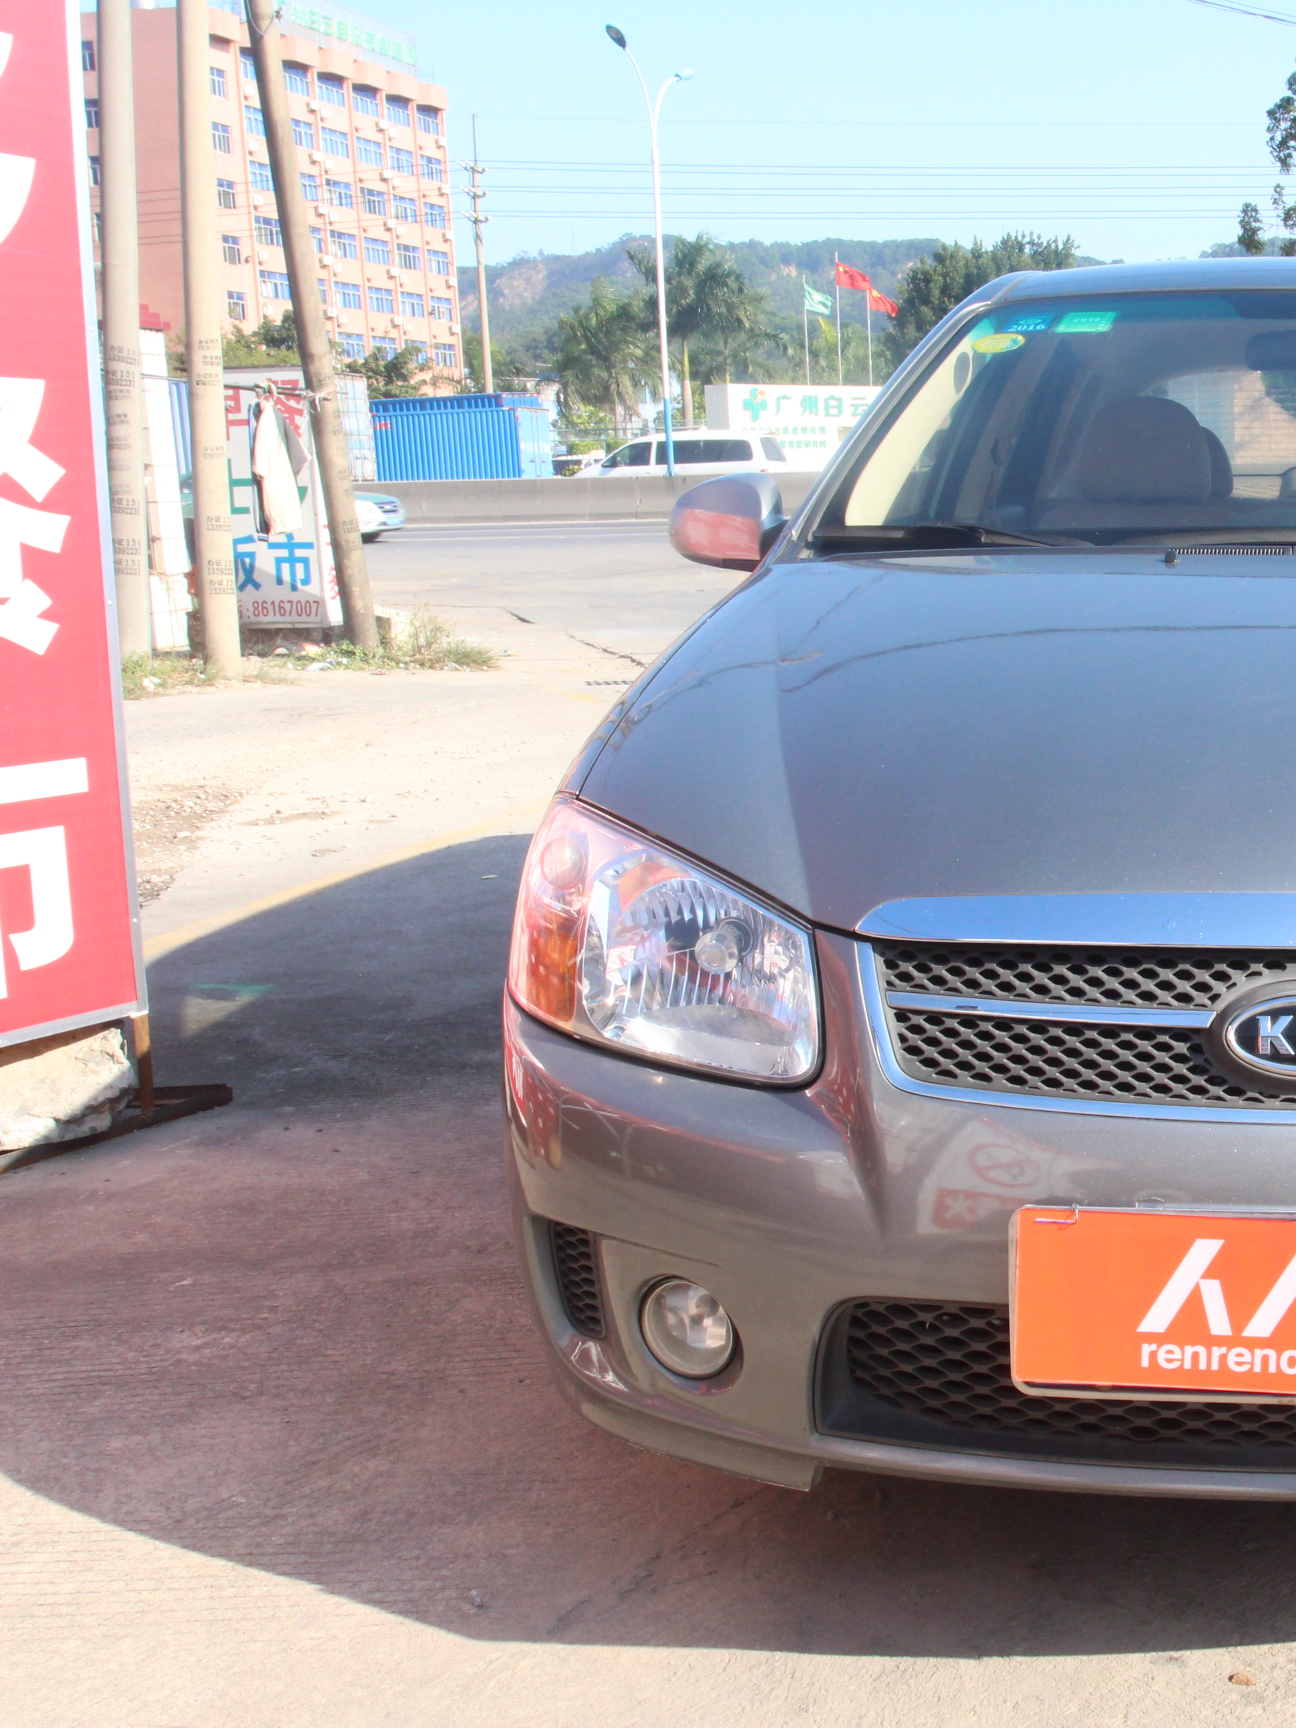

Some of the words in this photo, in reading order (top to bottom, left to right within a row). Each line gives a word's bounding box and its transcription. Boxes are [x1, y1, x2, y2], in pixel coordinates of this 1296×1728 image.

[1007, 324, 1046, 332] 2016
[775, 394, 870, 417] 广州白云
